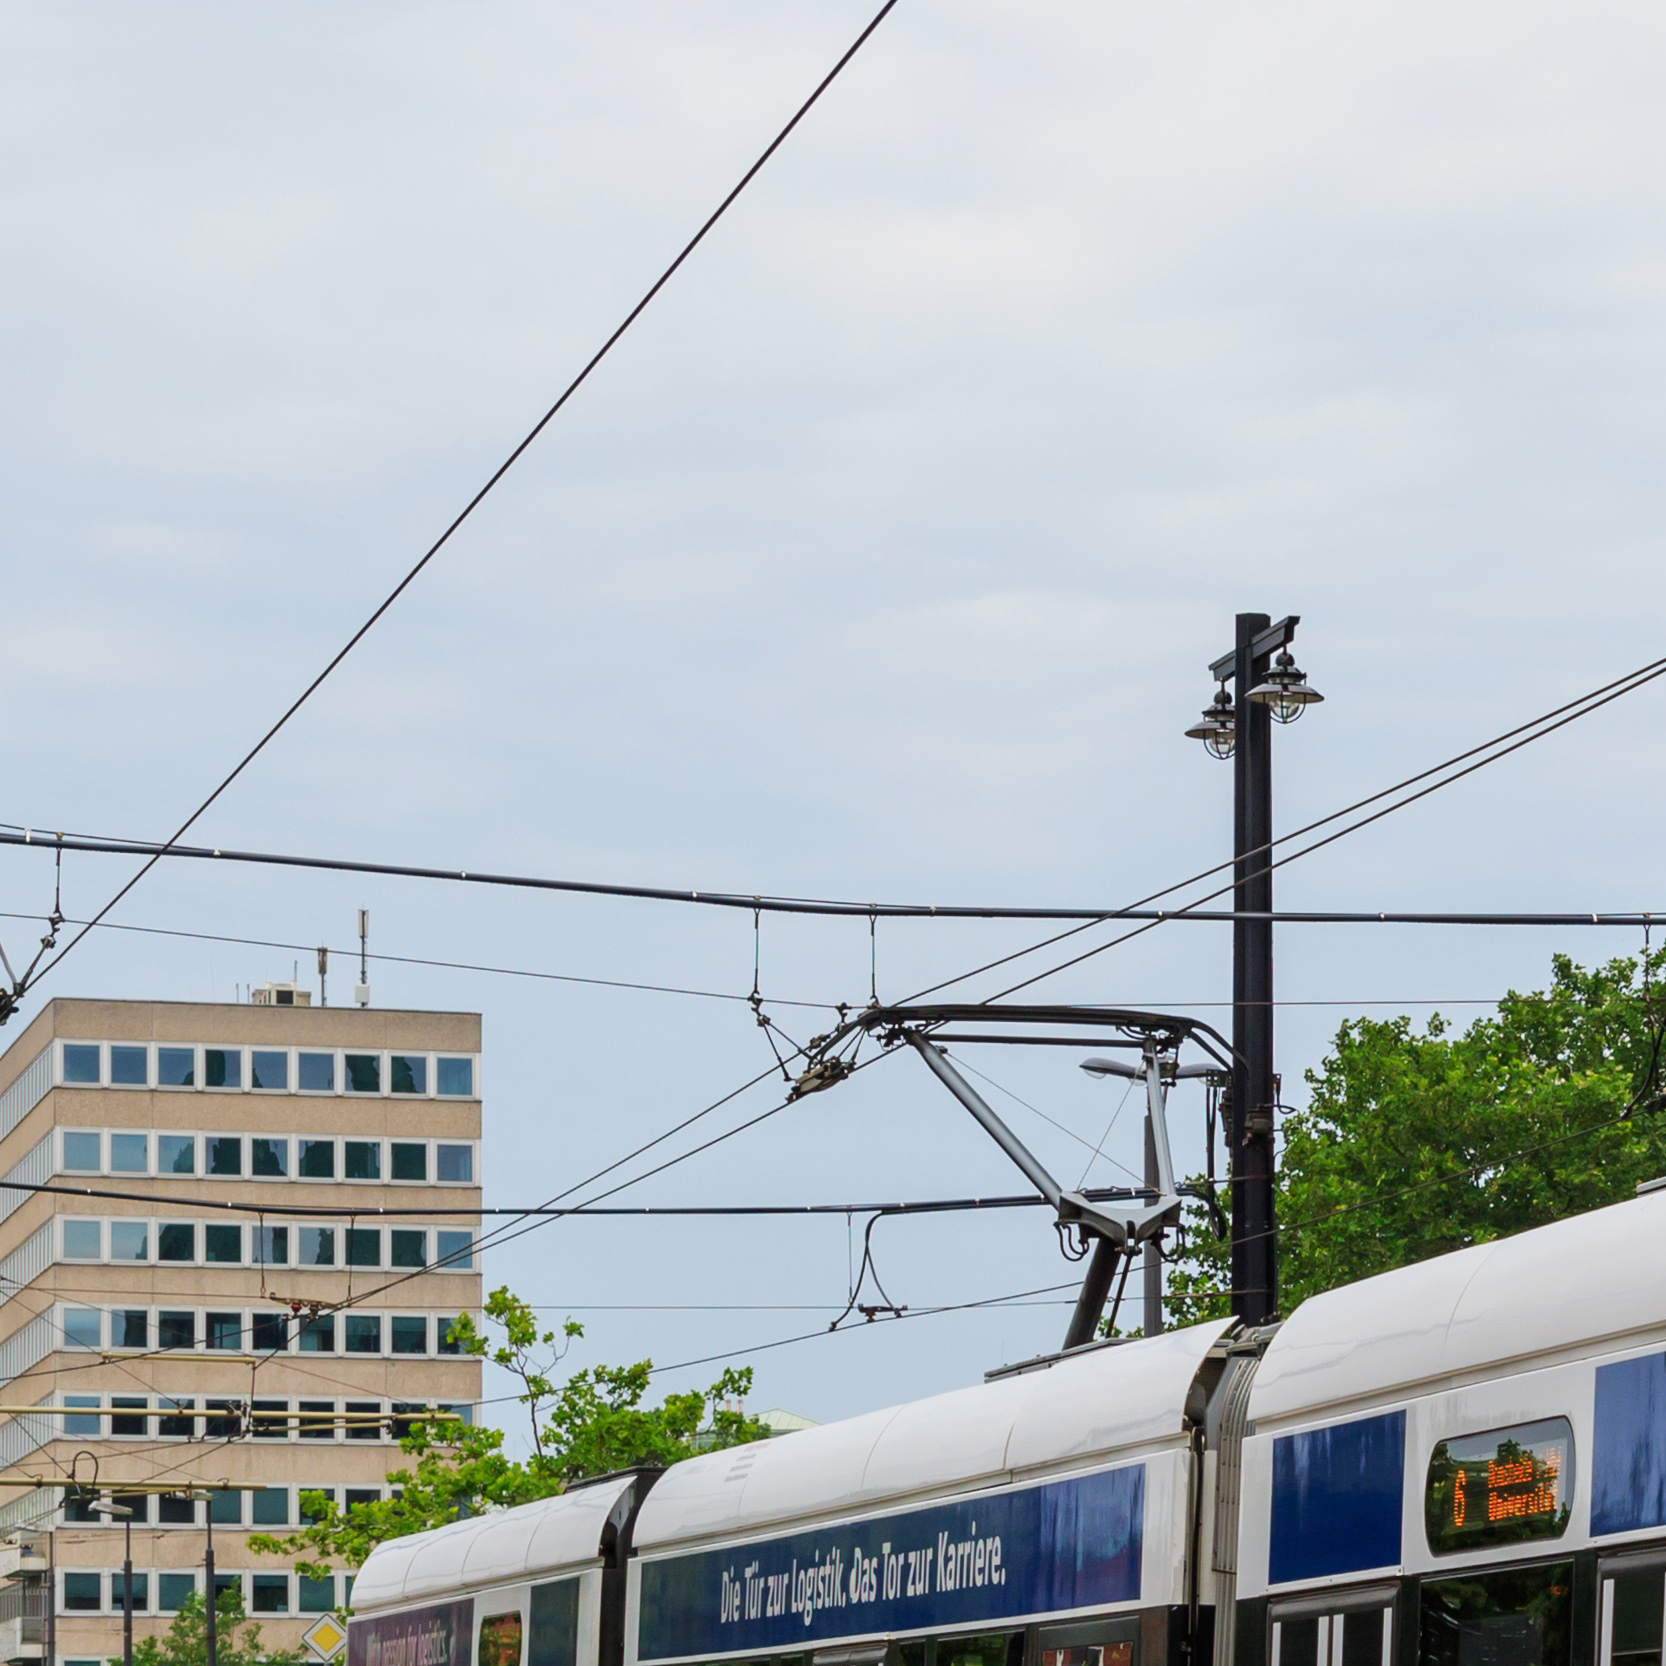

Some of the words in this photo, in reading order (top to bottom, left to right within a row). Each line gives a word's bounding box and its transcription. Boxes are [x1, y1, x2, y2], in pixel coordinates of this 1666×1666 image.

[1453, 1469, 1466, 1527] 6
[721, 1565, 741, 1624] Die
[744, 1560, 765, 1620] Tür
[766, 1572, 789, 1618] zur
[851, 1547, 878, 1605] Das
[882, 1542, 905, 1601] Tor
[907, 1547, 933, 1598] zur
[936, 1520, 1007, 1593] Karriere.
